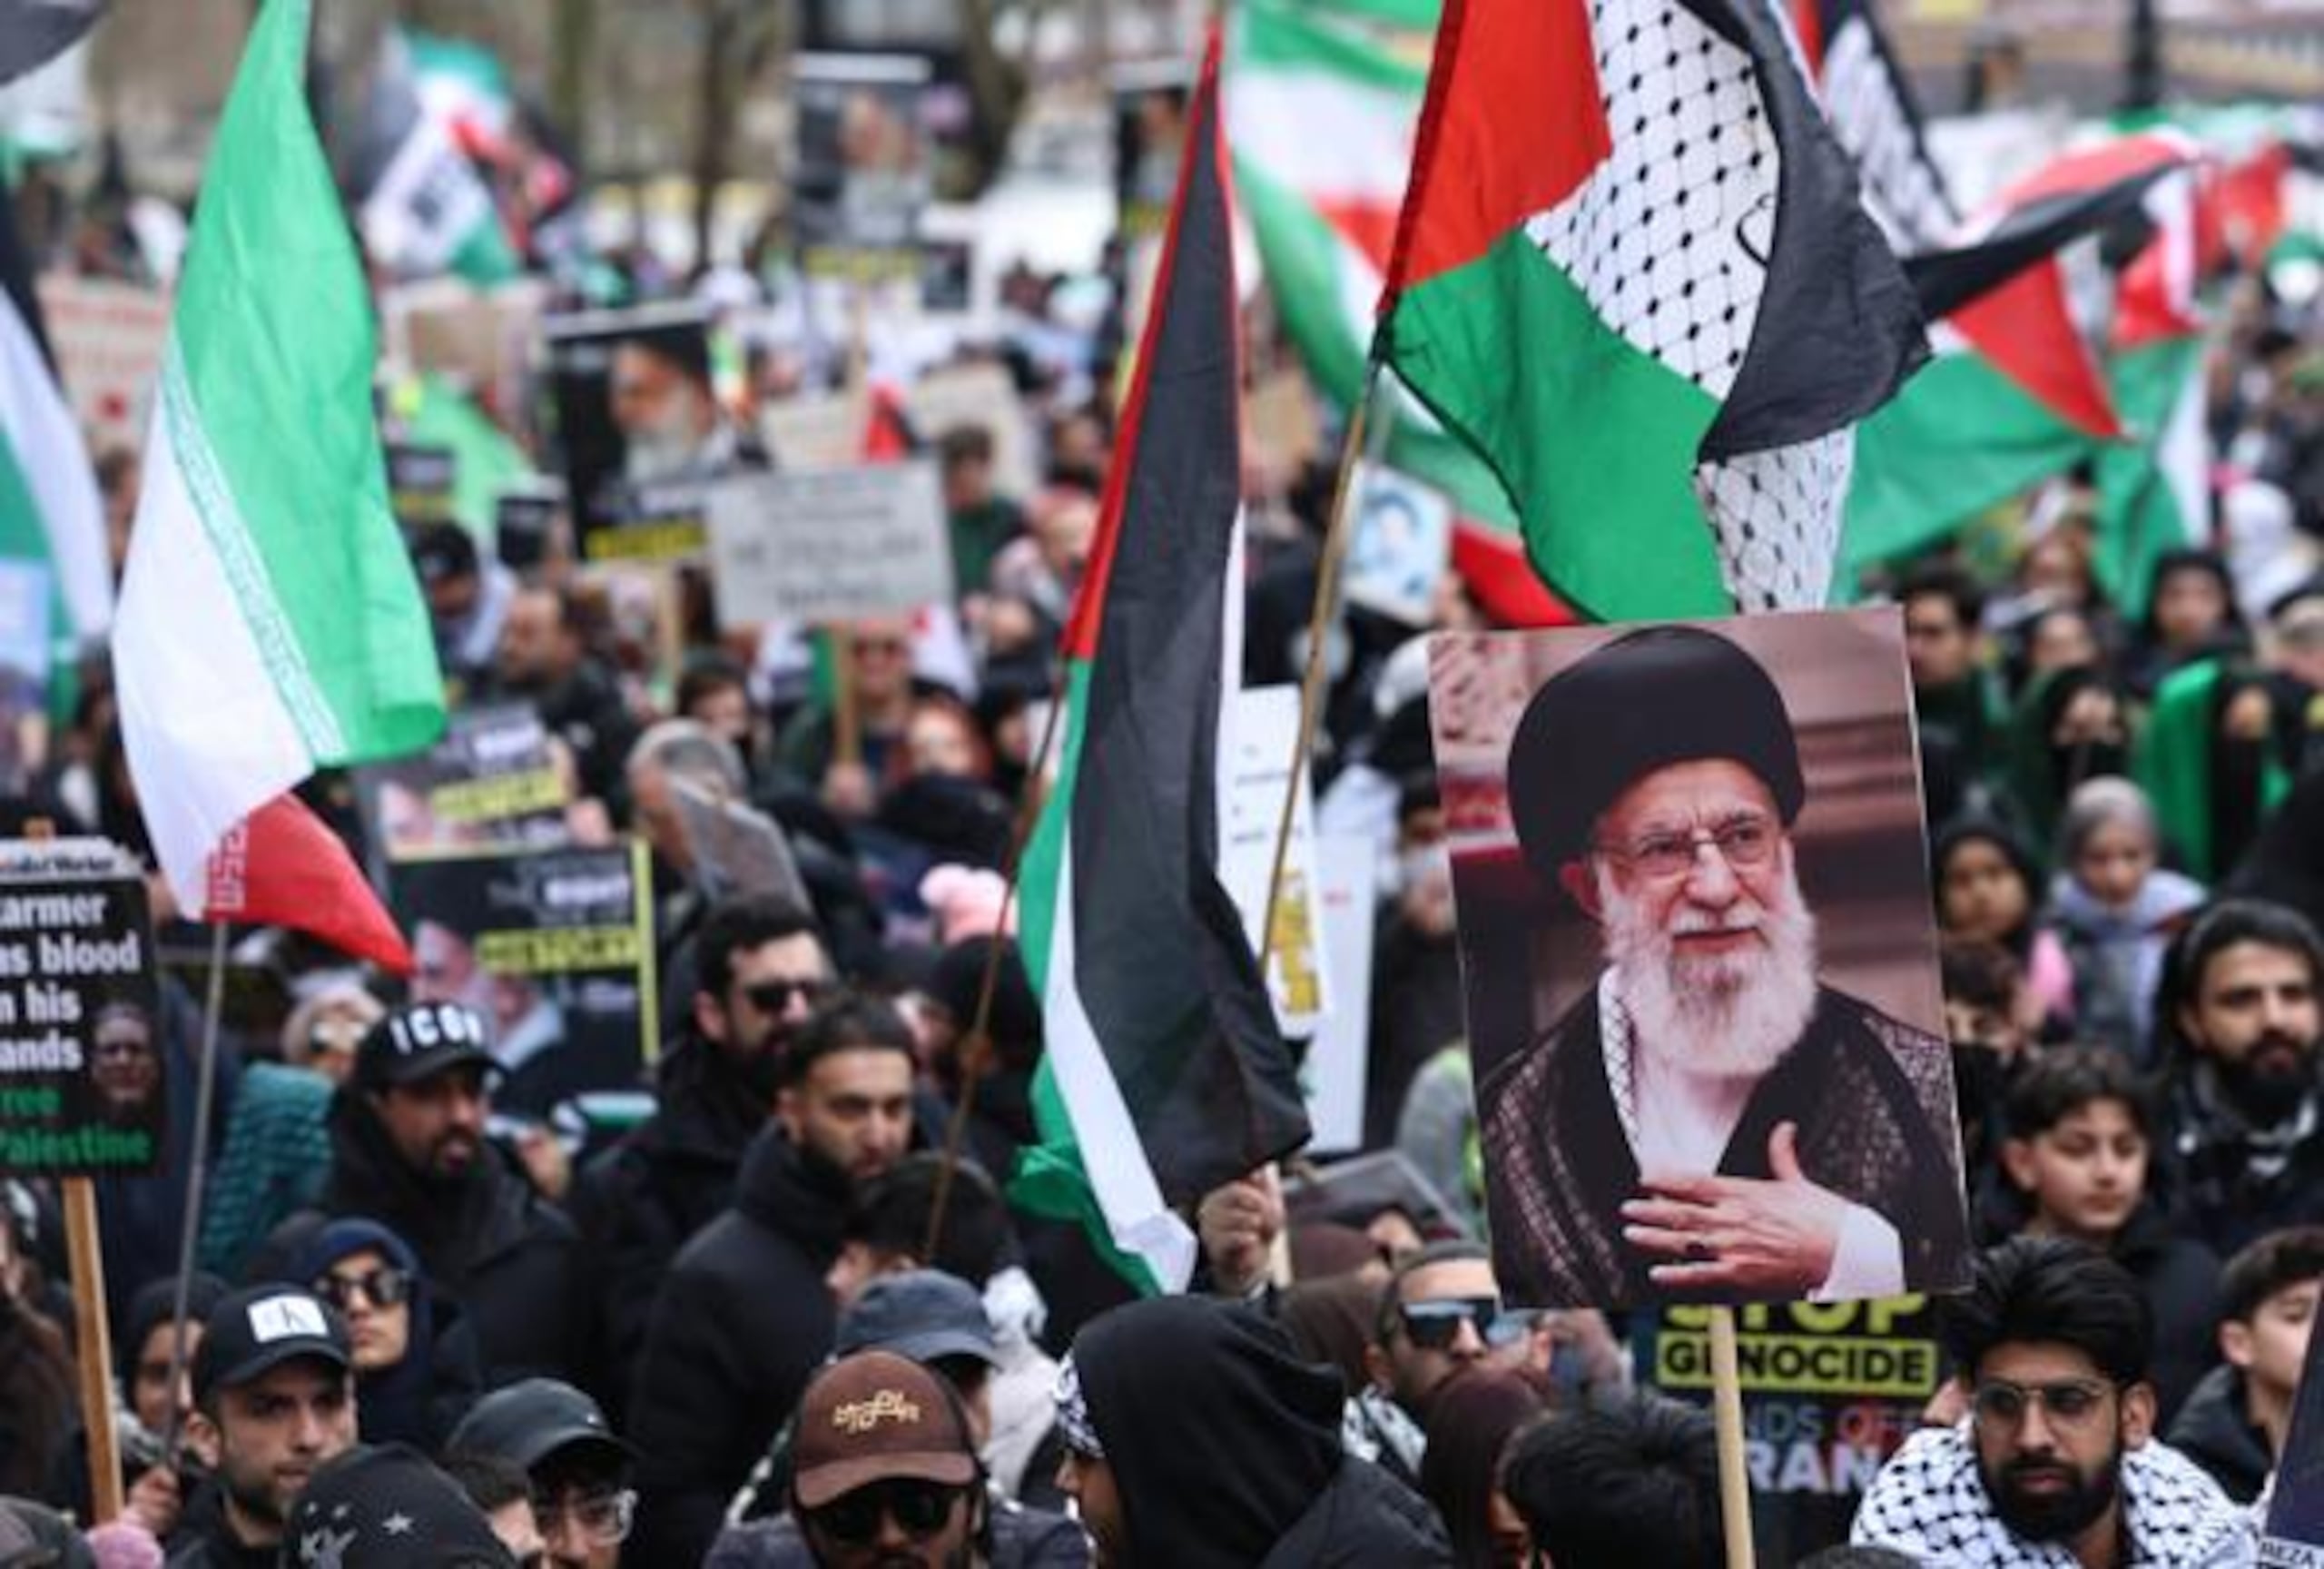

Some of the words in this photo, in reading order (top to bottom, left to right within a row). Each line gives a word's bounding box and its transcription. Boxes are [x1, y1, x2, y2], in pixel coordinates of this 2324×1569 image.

[0, 893, 106, 929] armer
[40, 931, 141, 975] blood
[25, 982, 83, 1022] his
